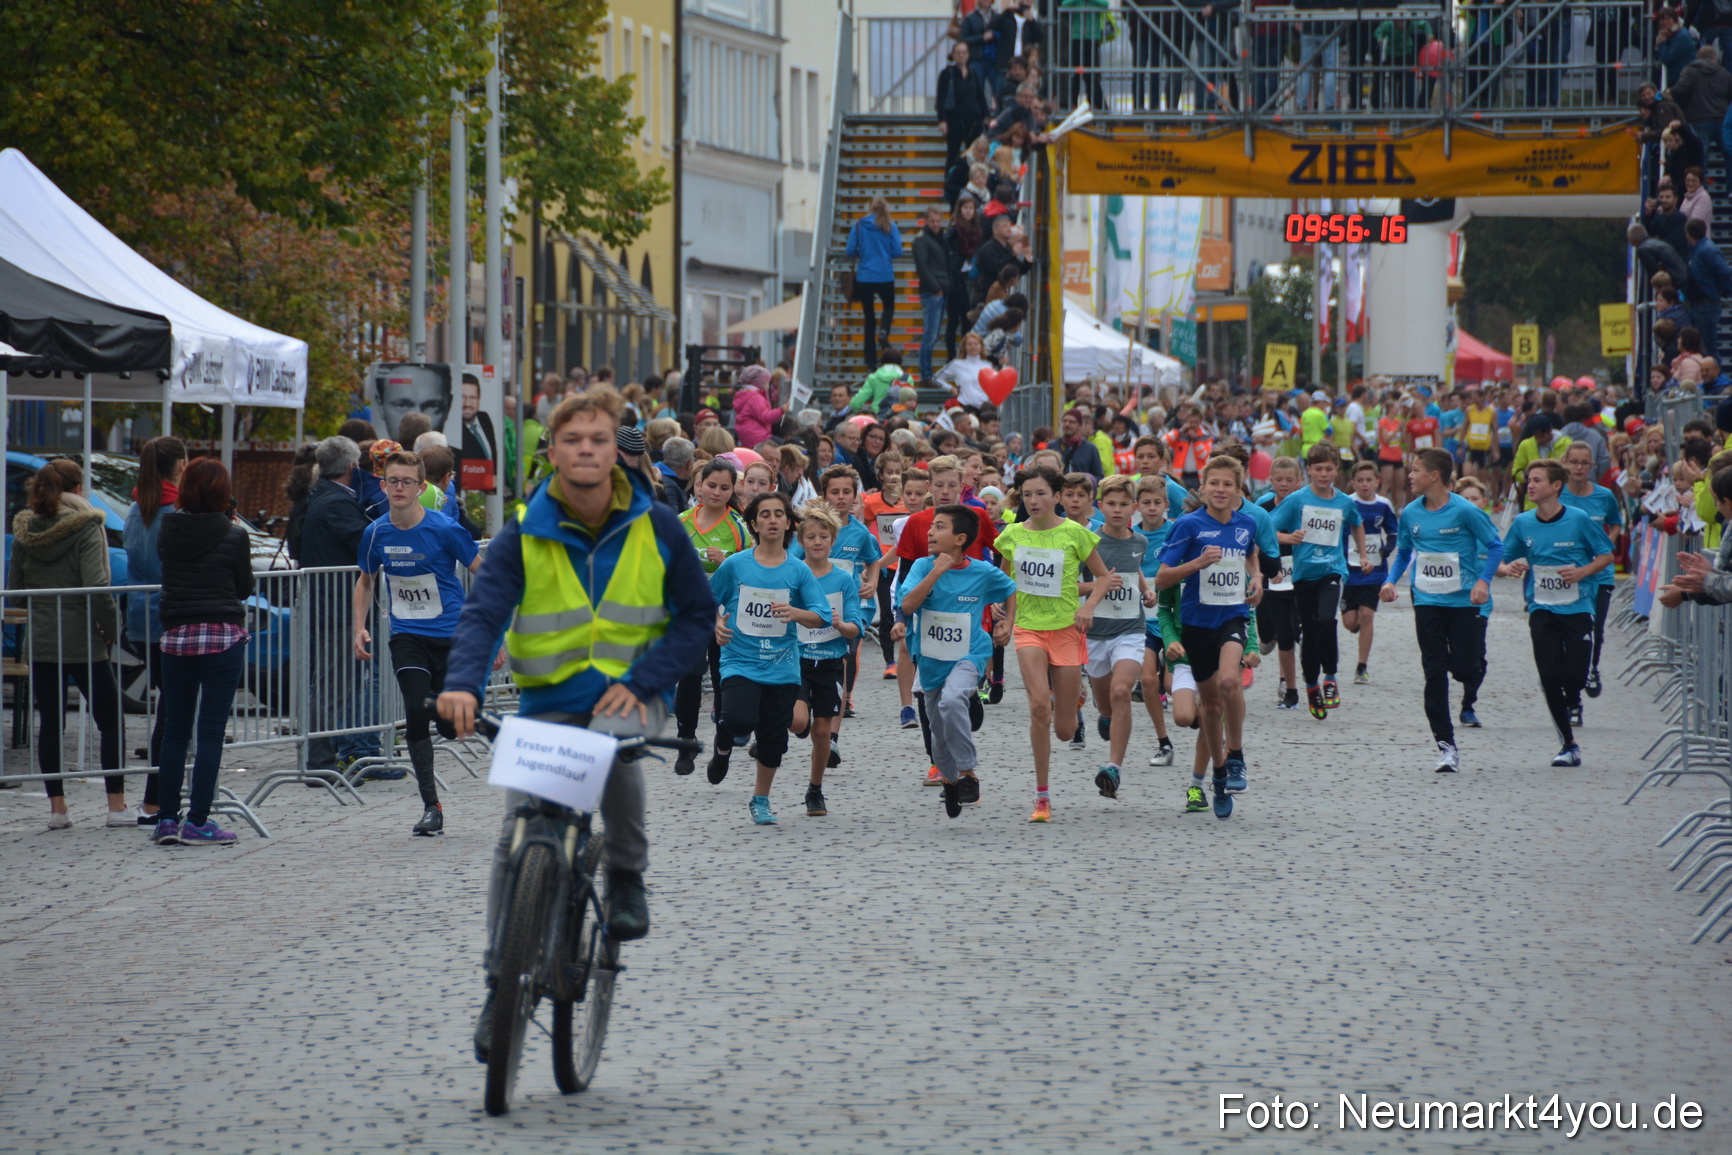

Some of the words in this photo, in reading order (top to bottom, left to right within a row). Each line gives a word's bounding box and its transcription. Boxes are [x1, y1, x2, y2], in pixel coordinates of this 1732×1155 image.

[1288, 143, 1415, 185] ZIEL
[1519, 337, 1532, 354] B
[1271, 359, 1287, 380] A
[1307, 517, 1336, 532] 4046
[1020, 560, 1055, 578] 4004
[1422, 564, 1453, 578] 4040
[1207, 571, 1240, 587] 4005
[398, 588, 431, 602] 4011
[745, 601, 781, 618] 402
[751, 621, 772, 629] Radwan
[927, 625, 963, 643] 4033
[515, 737, 554, 754] Erster
[557, 745, 596, 764] Mann
[515, 756, 588, 783] Jugendlauf
